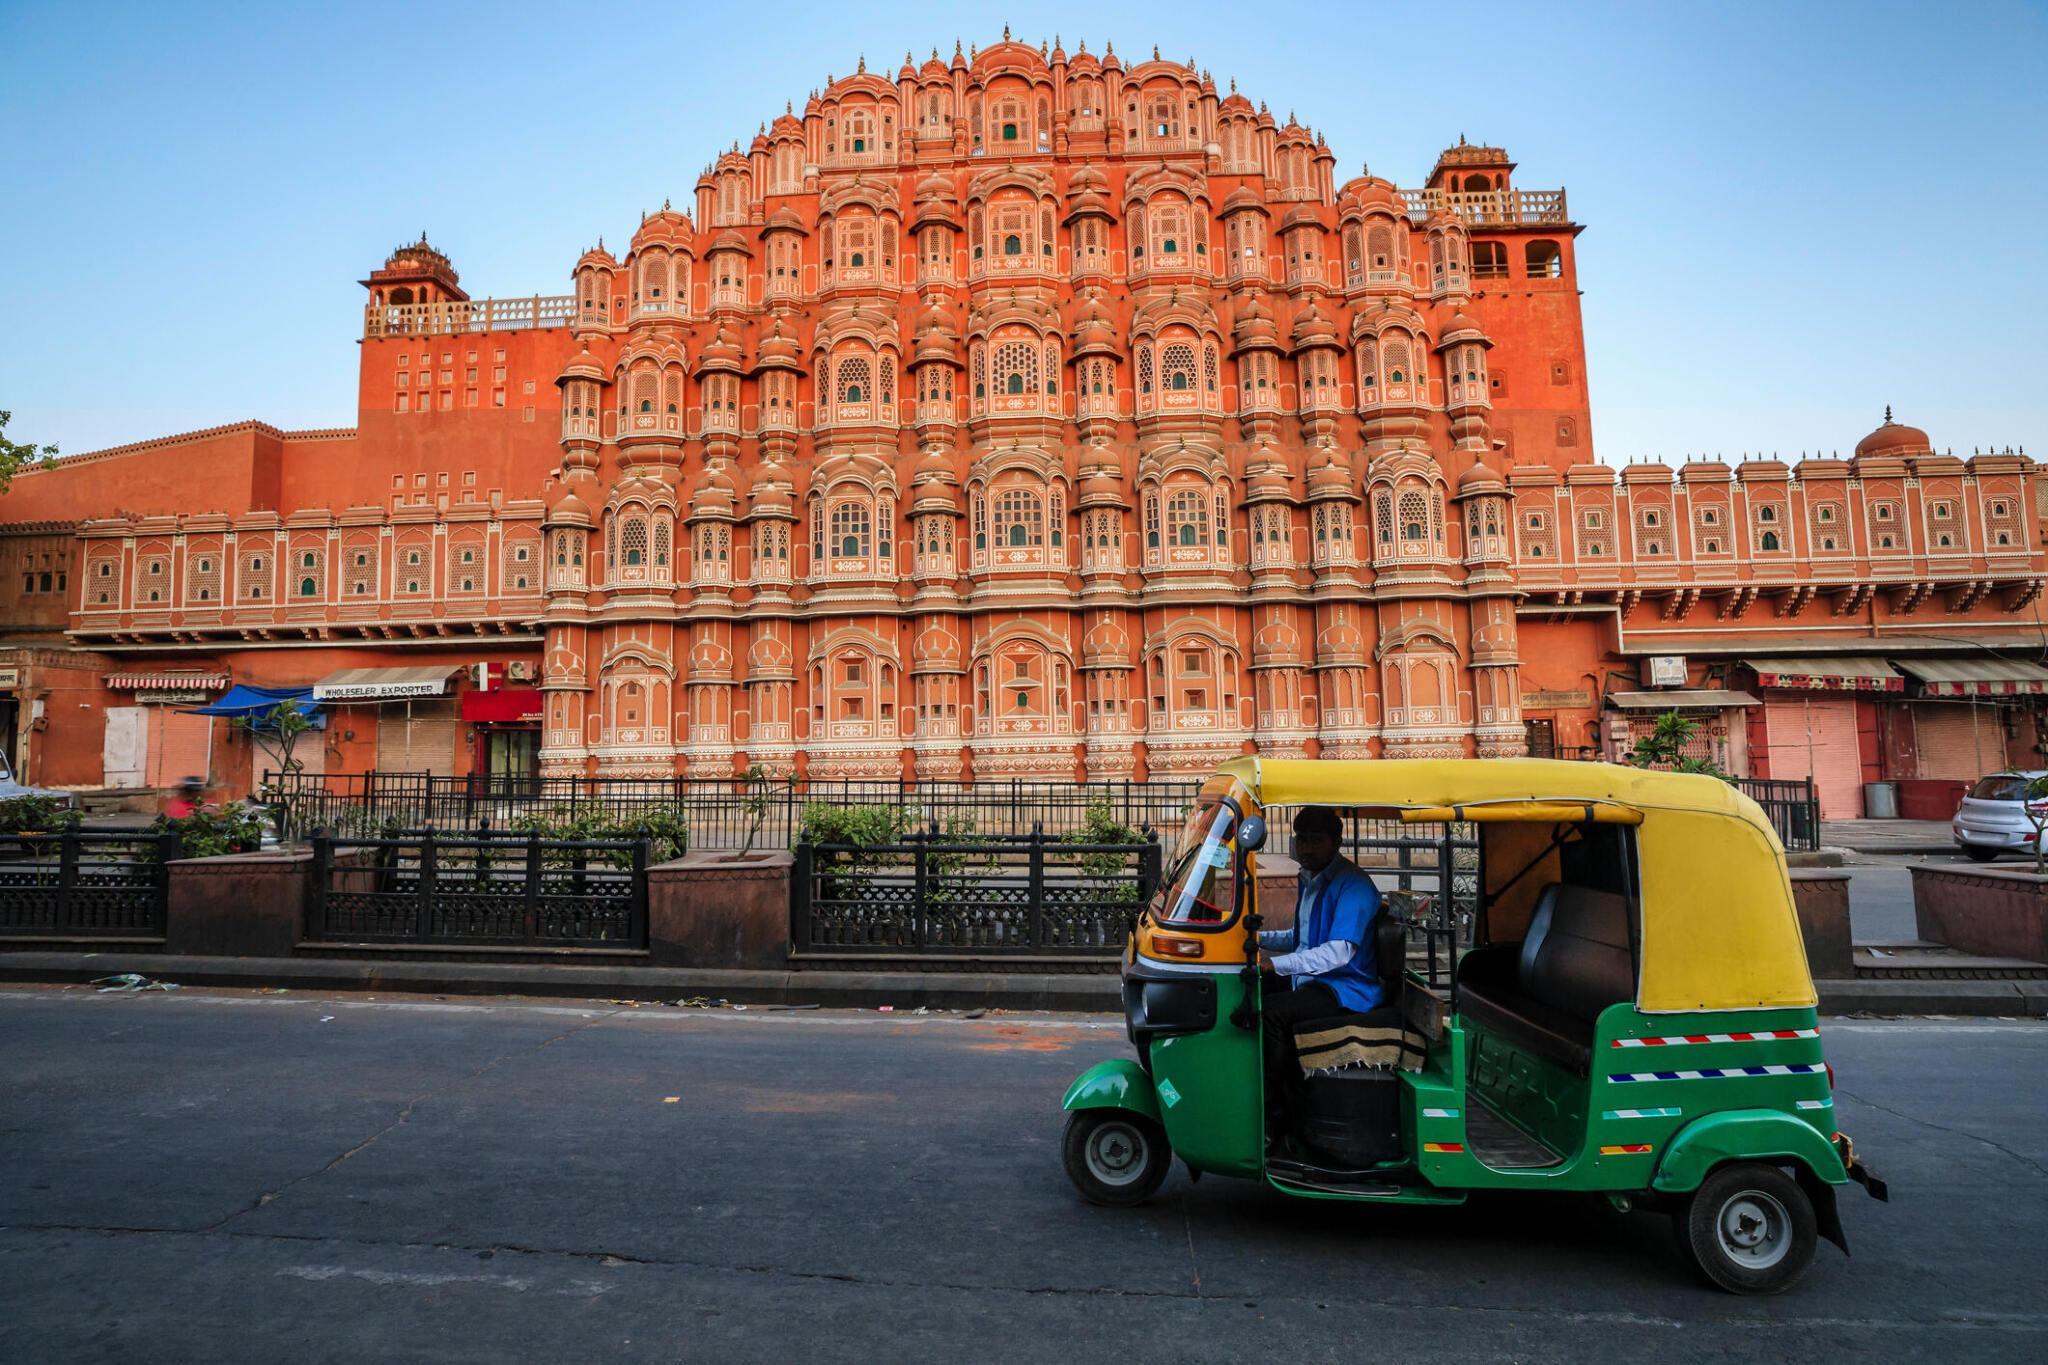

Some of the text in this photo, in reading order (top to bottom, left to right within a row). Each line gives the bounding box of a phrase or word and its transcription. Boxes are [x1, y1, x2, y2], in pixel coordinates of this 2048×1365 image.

[325, 685, 433, 696] WHOLESELER EXPORTER
[1711, 726, 1728, 737] GB
